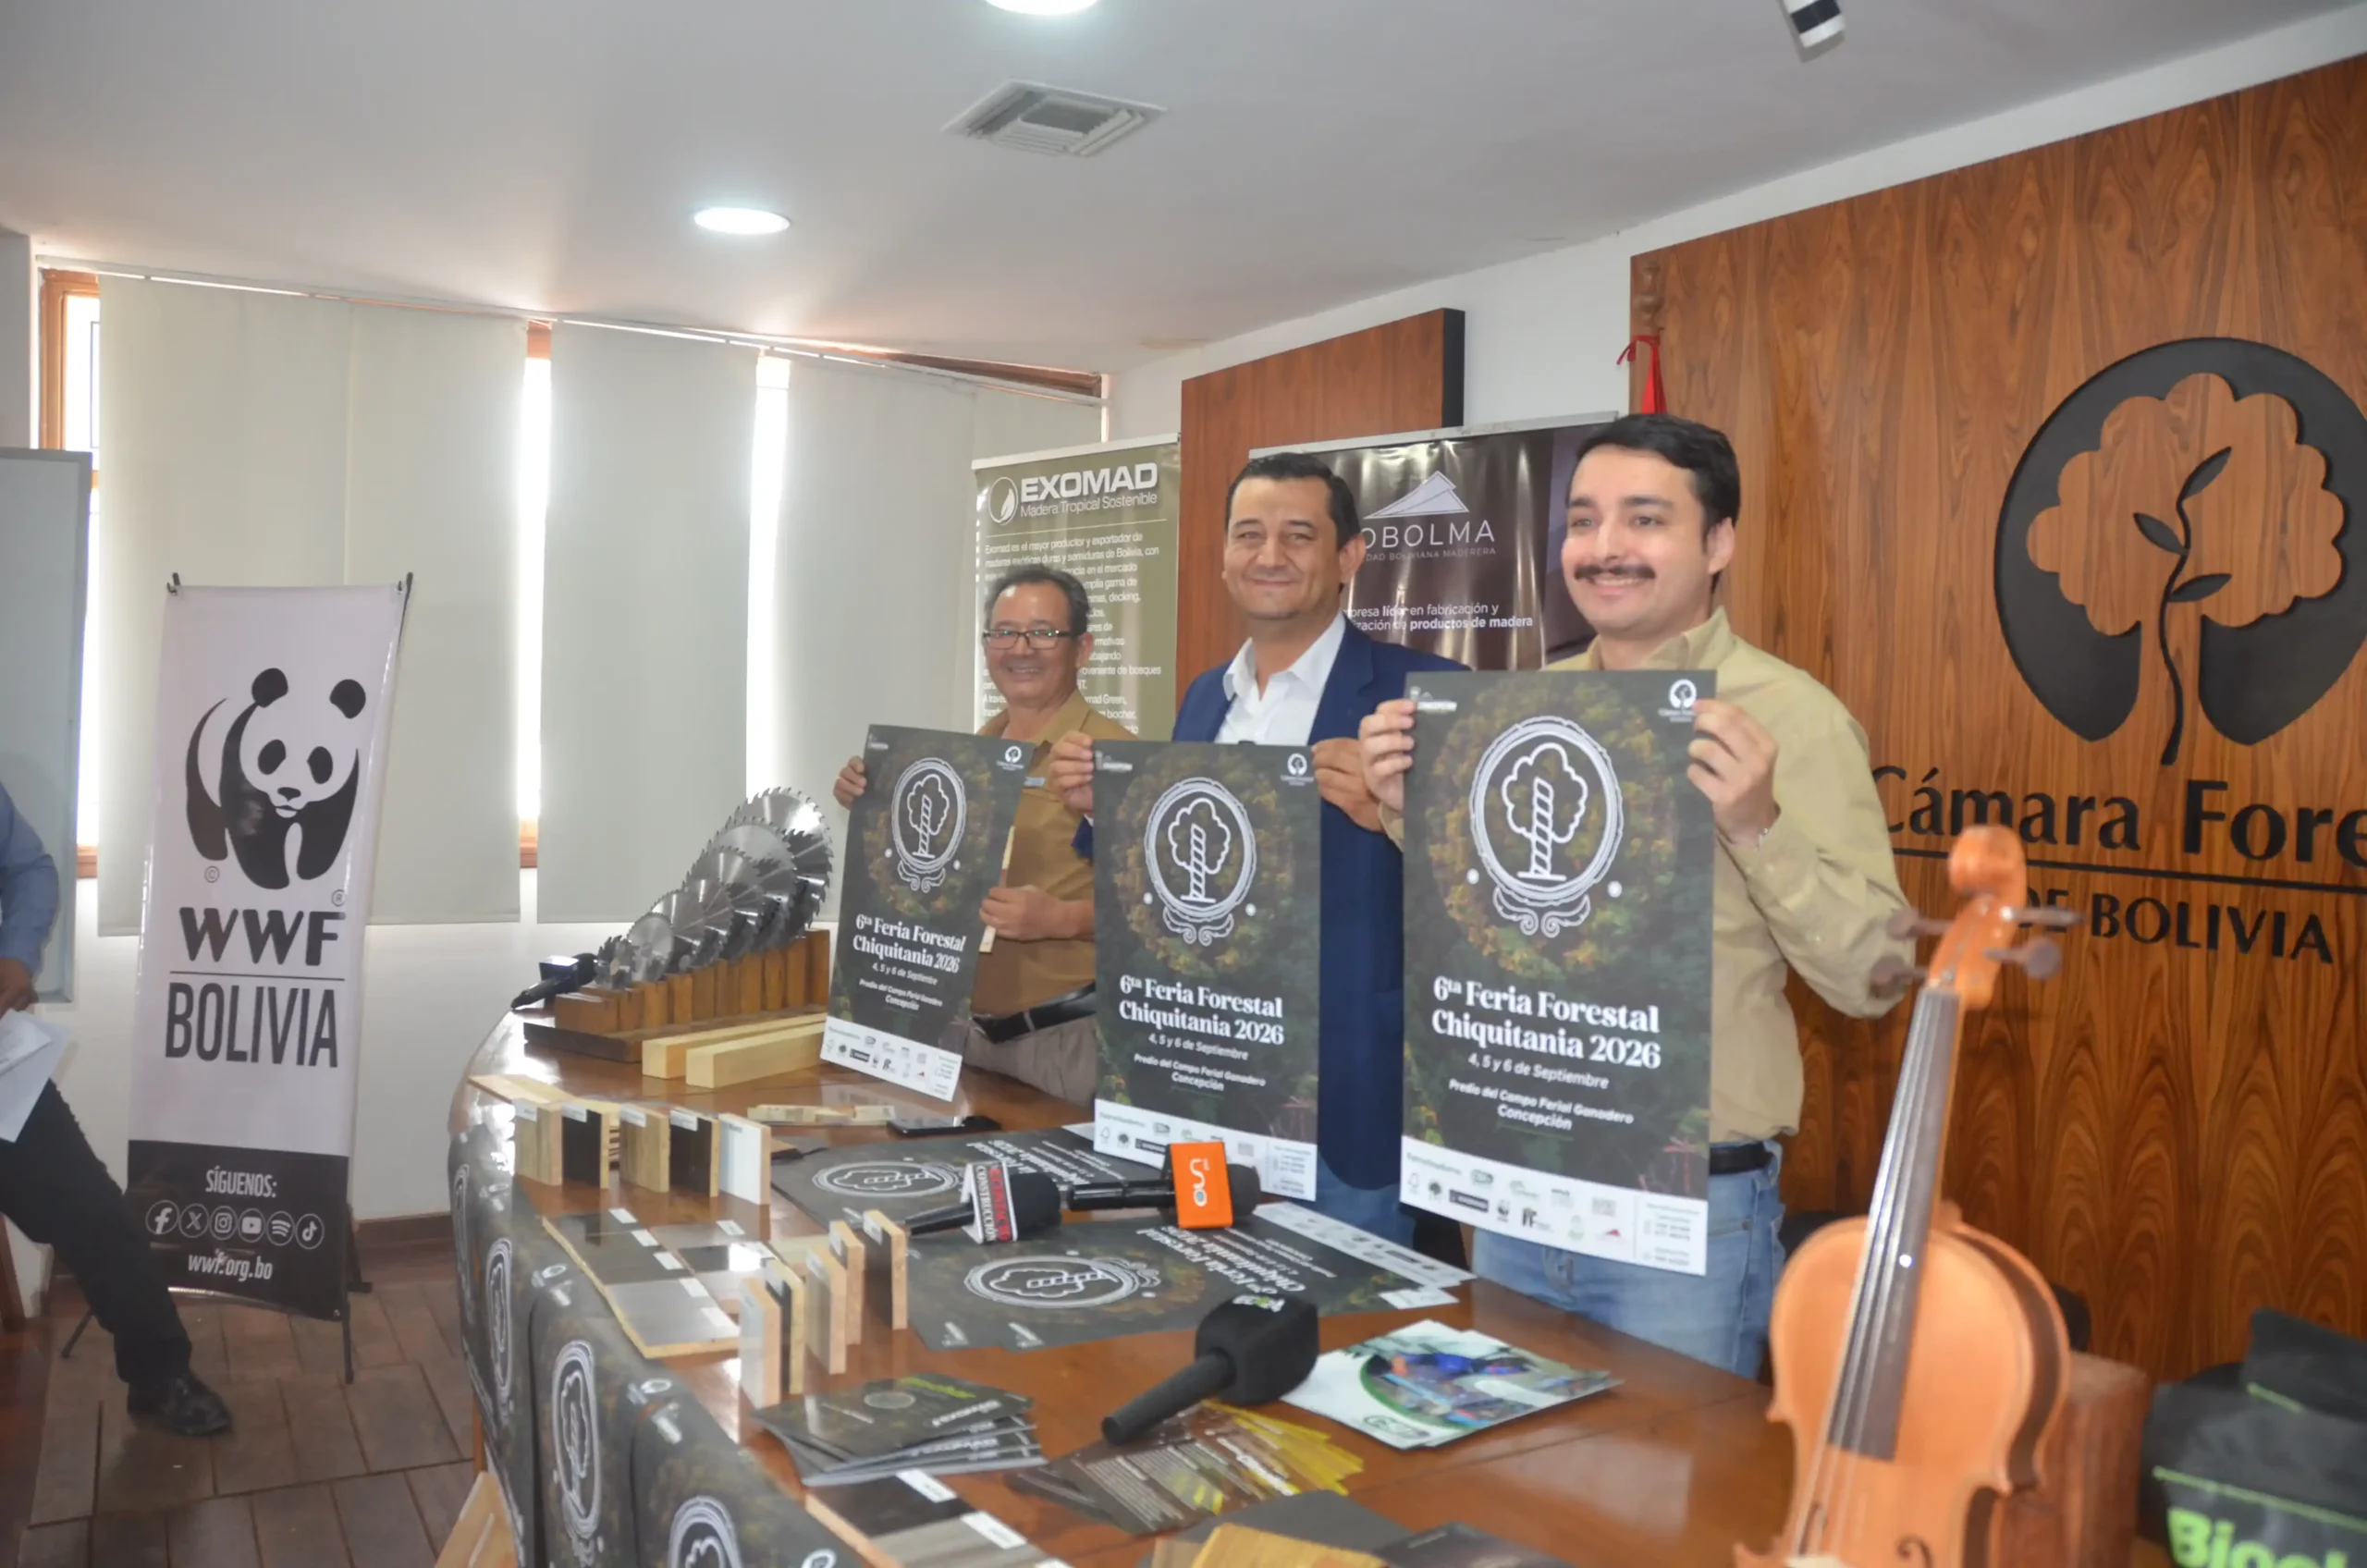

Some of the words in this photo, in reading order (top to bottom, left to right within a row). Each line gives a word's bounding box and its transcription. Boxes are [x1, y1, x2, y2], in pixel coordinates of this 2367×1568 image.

[1021, 462, 1158, 502] EXOMAD
[1021, 505, 1059, 517] Madera
[1061, 499, 1100, 515] Tropical
[1102, 493, 1157, 508] Sostenible
[1029, 543, 1049, 553] mayor
[1051, 538, 1085, 550] productor
[1092, 534, 1131, 546] exportador
[1133, 532, 1143, 542] de
[1361, 520, 1495, 549] OBOLMA
[1105, 563, 1137, 572] mercado
[1084, 580, 1104, 591] mplia
[1343, 606, 1380, 619] presa
[1410, 606, 1424, 616] en
[1427, 602, 1489, 616] fabricación
[1491, 605, 1499, 616] y
[1410, 618, 1467, 631] productos
[1469, 617, 1486, 628] de
[1490, 617, 1533, 628] madera
[1129, 665, 1161, 677] bosques
[1872, 765, 2140, 851] Cámara
[179, 907, 346, 966] WWF
[874, 916, 910, 940] Feria
[913, 925, 966, 951] Forestal
[2091, 893, 2334, 963] BOLIVIA
[852, 935, 934, 967] Chiquitania
[1145, 978, 1194, 1005] Feria
[1197, 986, 1283, 1018] Forestal
[1466, 980, 1532, 1016] Feria
[1538, 990, 1661, 1034] Forestal
[166, 982, 337, 1068] BOLIVIA
[1119, 1000, 1231, 1037] Chiquitania
[1233, 1019, 1284, 1046] 2026
[1432, 1009, 1584, 1059] Chiquitania
[1588, 1035, 1662, 1069] 2026
[1159, 1035, 1166, 1045] 5
[1174, 1037, 1182, 1047] 6
[1183, 1039, 1195, 1050] de
[1468, 1053, 1479, 1068] 4,
[1482, 1055, 1491, 1068] 5
[1492, 1060, 1502, 1072] y
[1503, 1059, 1513, 1072] 6
[1514, 1060, 1530, 1076] de
[1532, 1064, 1609, 1089] Septiembre
[1497, 1104, 1572, 1130] Concepción
[205, 1165, 276, 1197] SÍGUENOS:
[975, 1165, 997, 1241] CONSTRUCCIÓN
[2166, 1507, 2349, 1568] Bio
